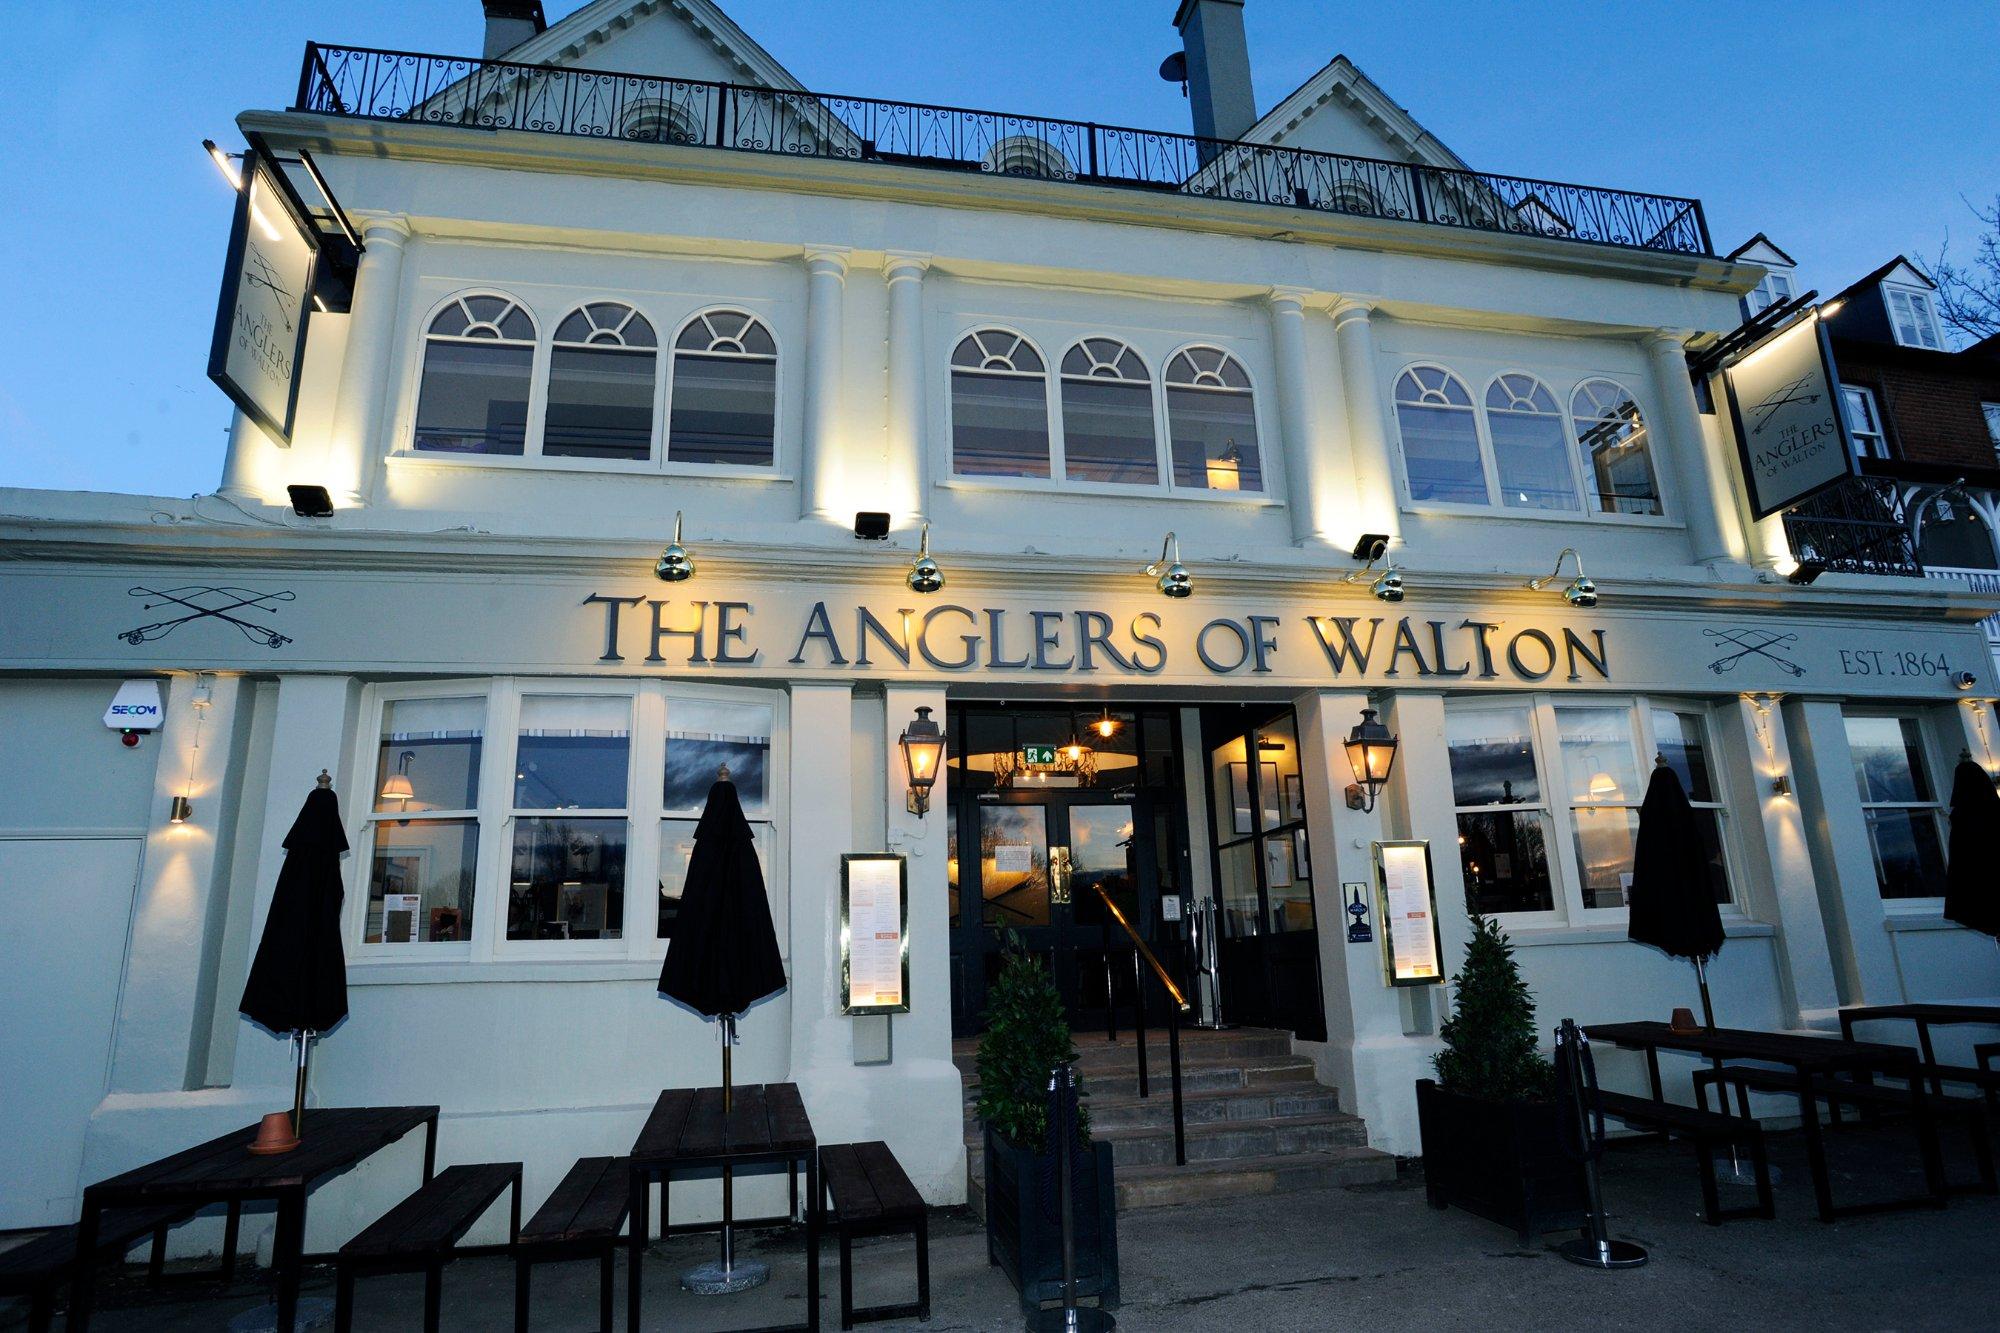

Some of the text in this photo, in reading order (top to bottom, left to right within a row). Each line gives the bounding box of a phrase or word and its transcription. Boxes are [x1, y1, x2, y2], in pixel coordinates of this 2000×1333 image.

[233, 304, 291, 379] ANGLERS
[239, 335, 250, 350] OF
[1755, 417, 1835, 470] ANGLERS
[1779, 424, 1800, 439] THE
[1766, 441, 1826, 477] OF WALTON
[582, 592, 1609, 678] THE ANGLERS OF WALTON
[112, 705, 157, 715] SECOM
